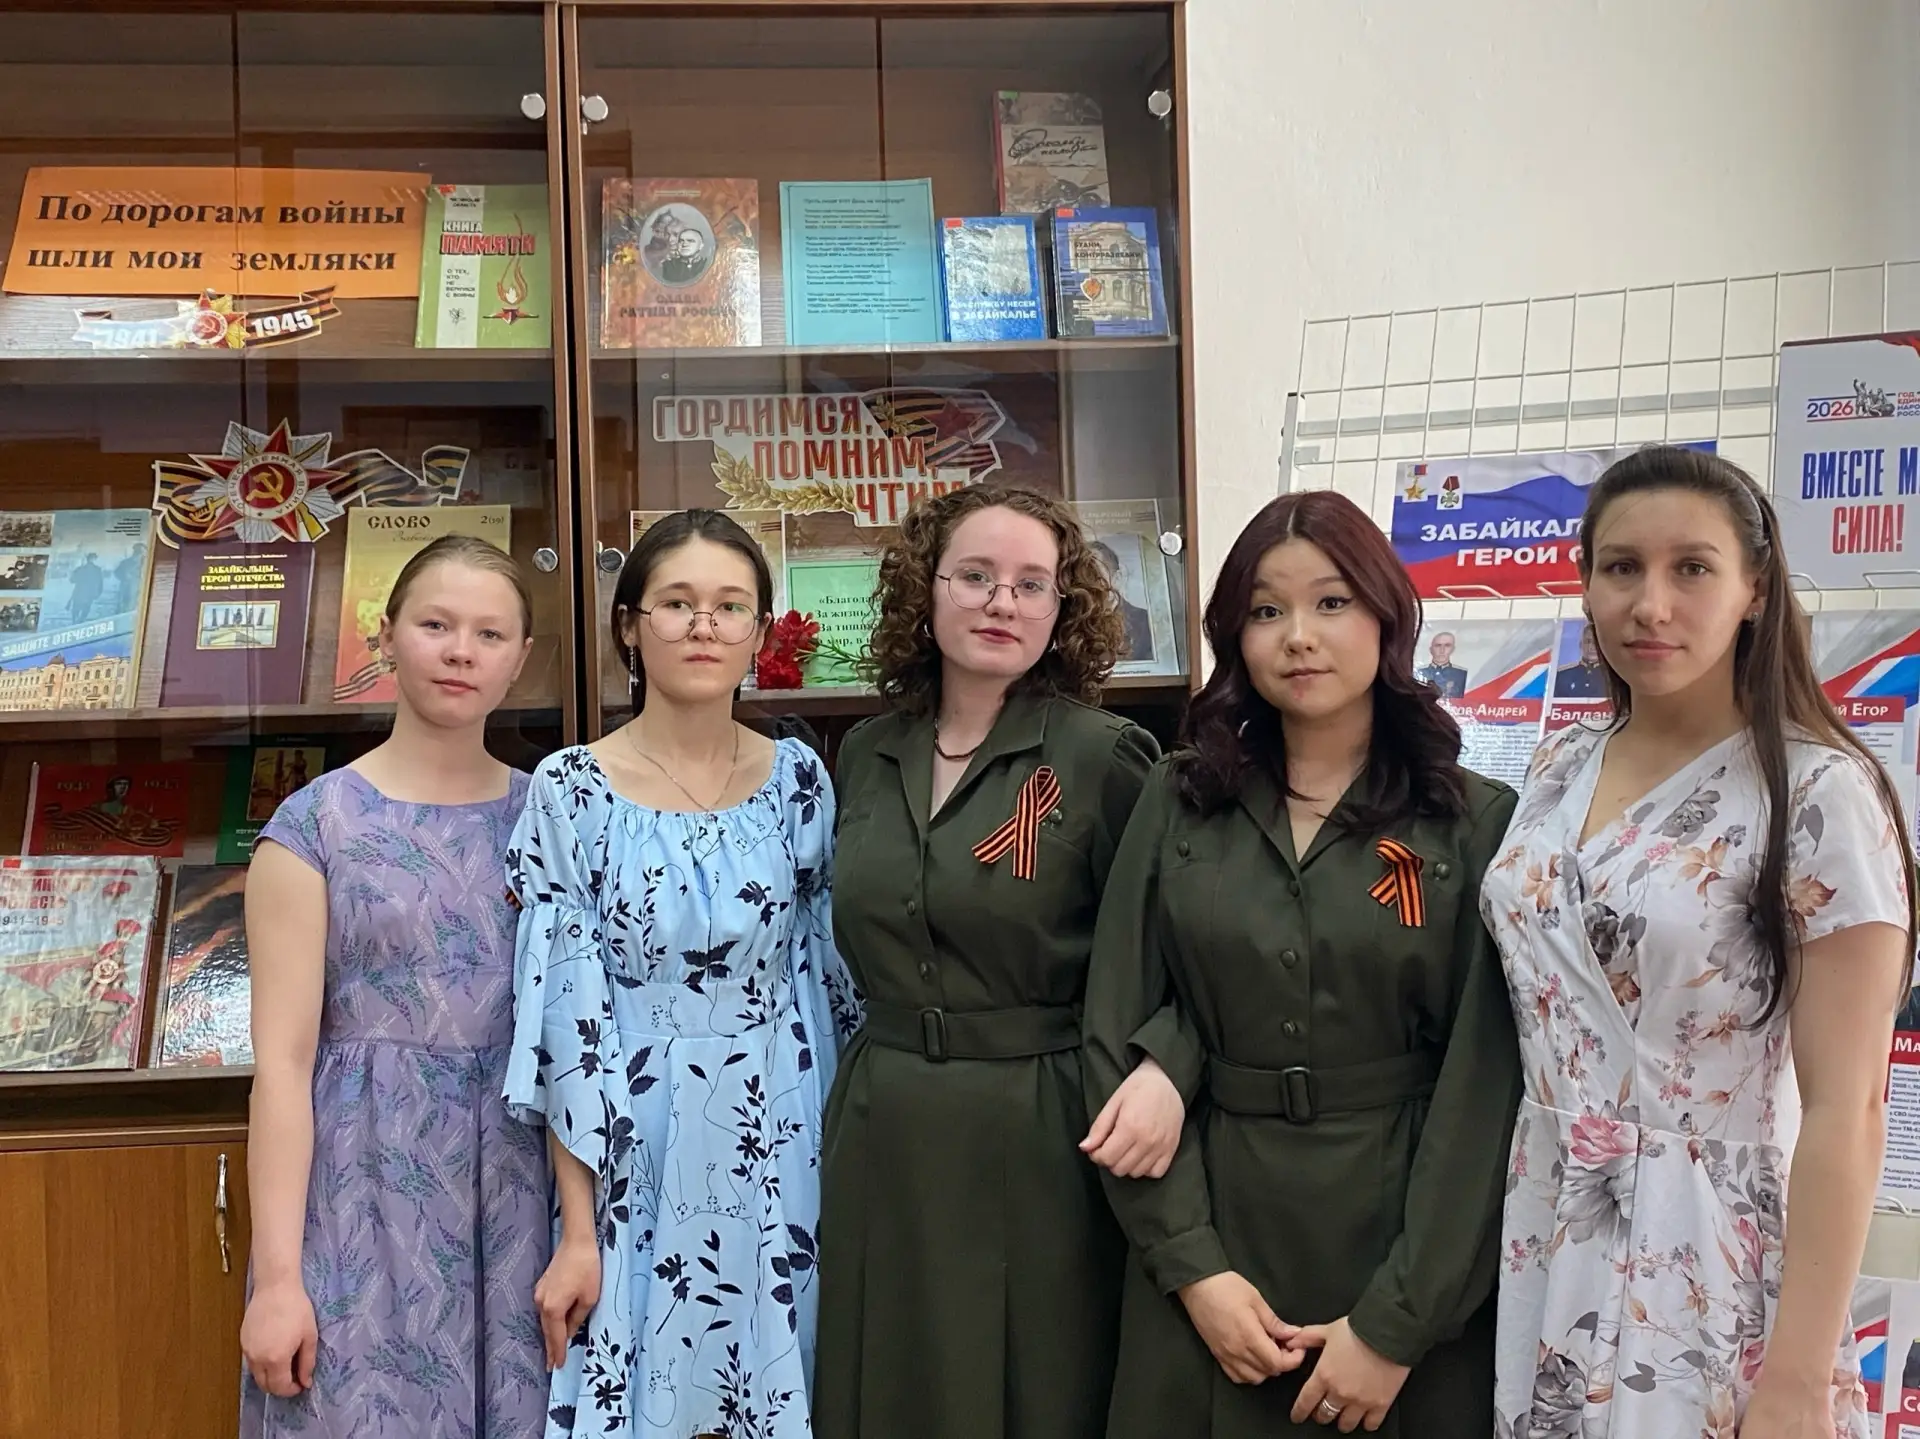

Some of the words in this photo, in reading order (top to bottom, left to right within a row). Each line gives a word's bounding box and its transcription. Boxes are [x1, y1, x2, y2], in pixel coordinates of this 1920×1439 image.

[36, 195, 92, 221] По
[101, 203, 265, 228] дорогам
[278, 200, 406, 224] войны
[441, 220, 483, 233] КНИГА
[440, 233, 536, 256] ПАМЯТИ
[27, 249, 115, 268] шли
[126, 250, 203, 269] мои
[229, 252, 397, 271] земляки
[963, 309, 1038, 320] ЗАБАЙКАЛЬЕ
[1007, 300, 1036, 308] НЕСЕМ
[250, 309, 314, 338] 1945
[655, 395, 873, 439] ГОРДИМСЯ,
[1806, 400, 1854, 418] 2026
[753, 435, 938, 480] ПОМНИМ,
[1801, 448, 1885, 500] ВМЕСТЕ
[367, 515, 431, 529] СЛОВО
[1832, 503, 1905, 555] СИЛА!
[1456, 546, 1558, 567] ГЕРОИ
[201, 574, 231, 583] ГЕРОИ
[234, 573, 286, 583] ОТЕЧЕСТВА
[208, 564, 274, 574] ЗАБАЙКАЛЬЦЫ
[816, 609, 828, 619] За
[52, 620, 116, 647] ОТЕЧЕСТВА
[820, 622, 832, 632] За
